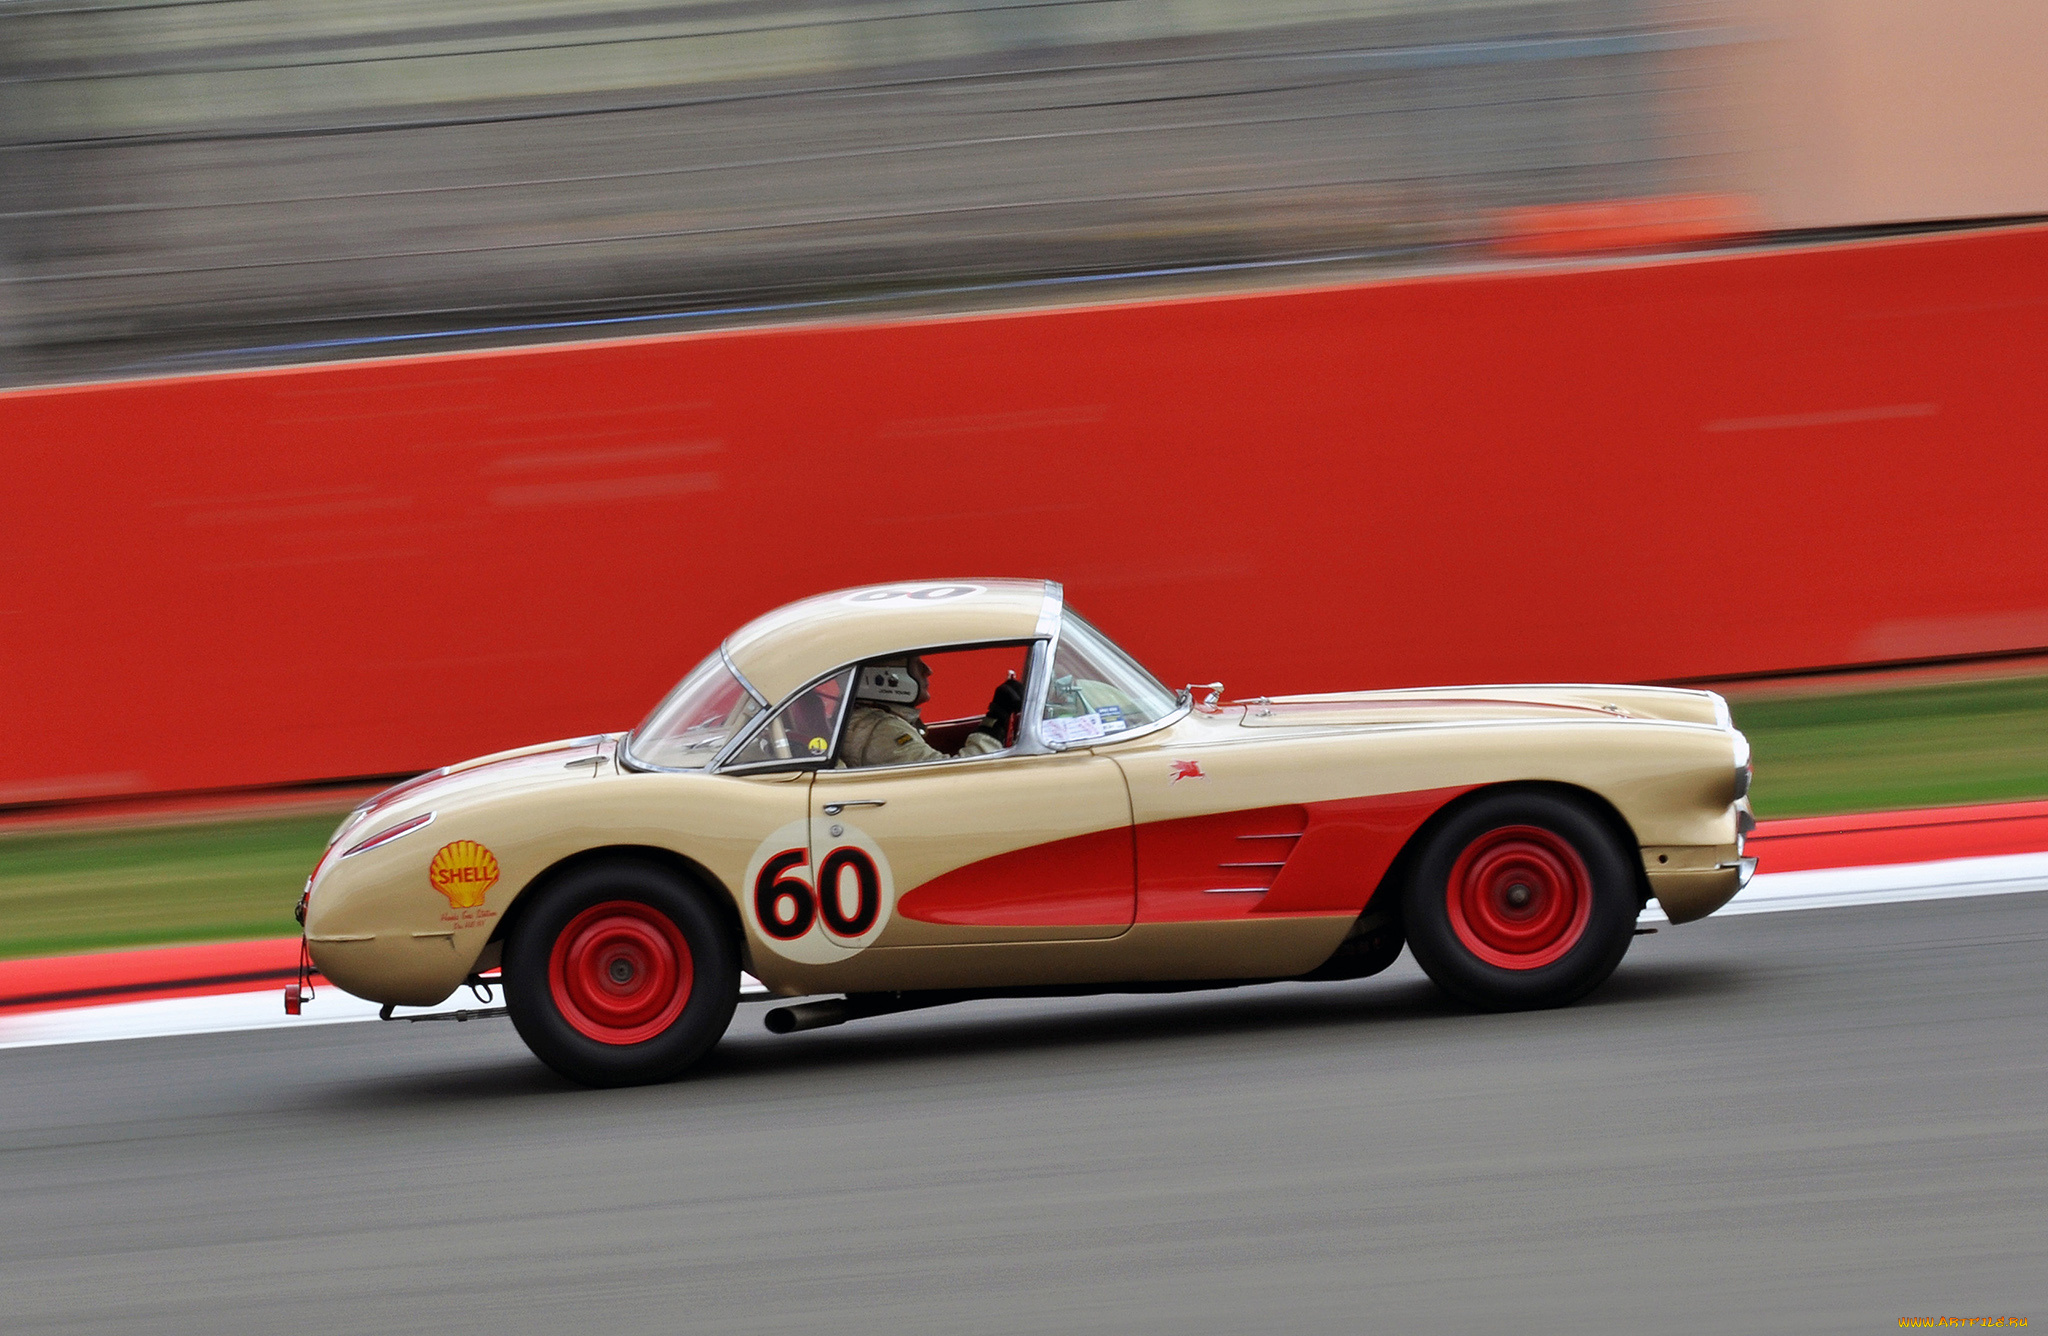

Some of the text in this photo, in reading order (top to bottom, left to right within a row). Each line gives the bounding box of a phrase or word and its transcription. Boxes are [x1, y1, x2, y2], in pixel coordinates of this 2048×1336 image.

[850, 586, 977, 602] 60
[438, 866, 493, 884] SHELL
[753, 845, 882, 941] 60
